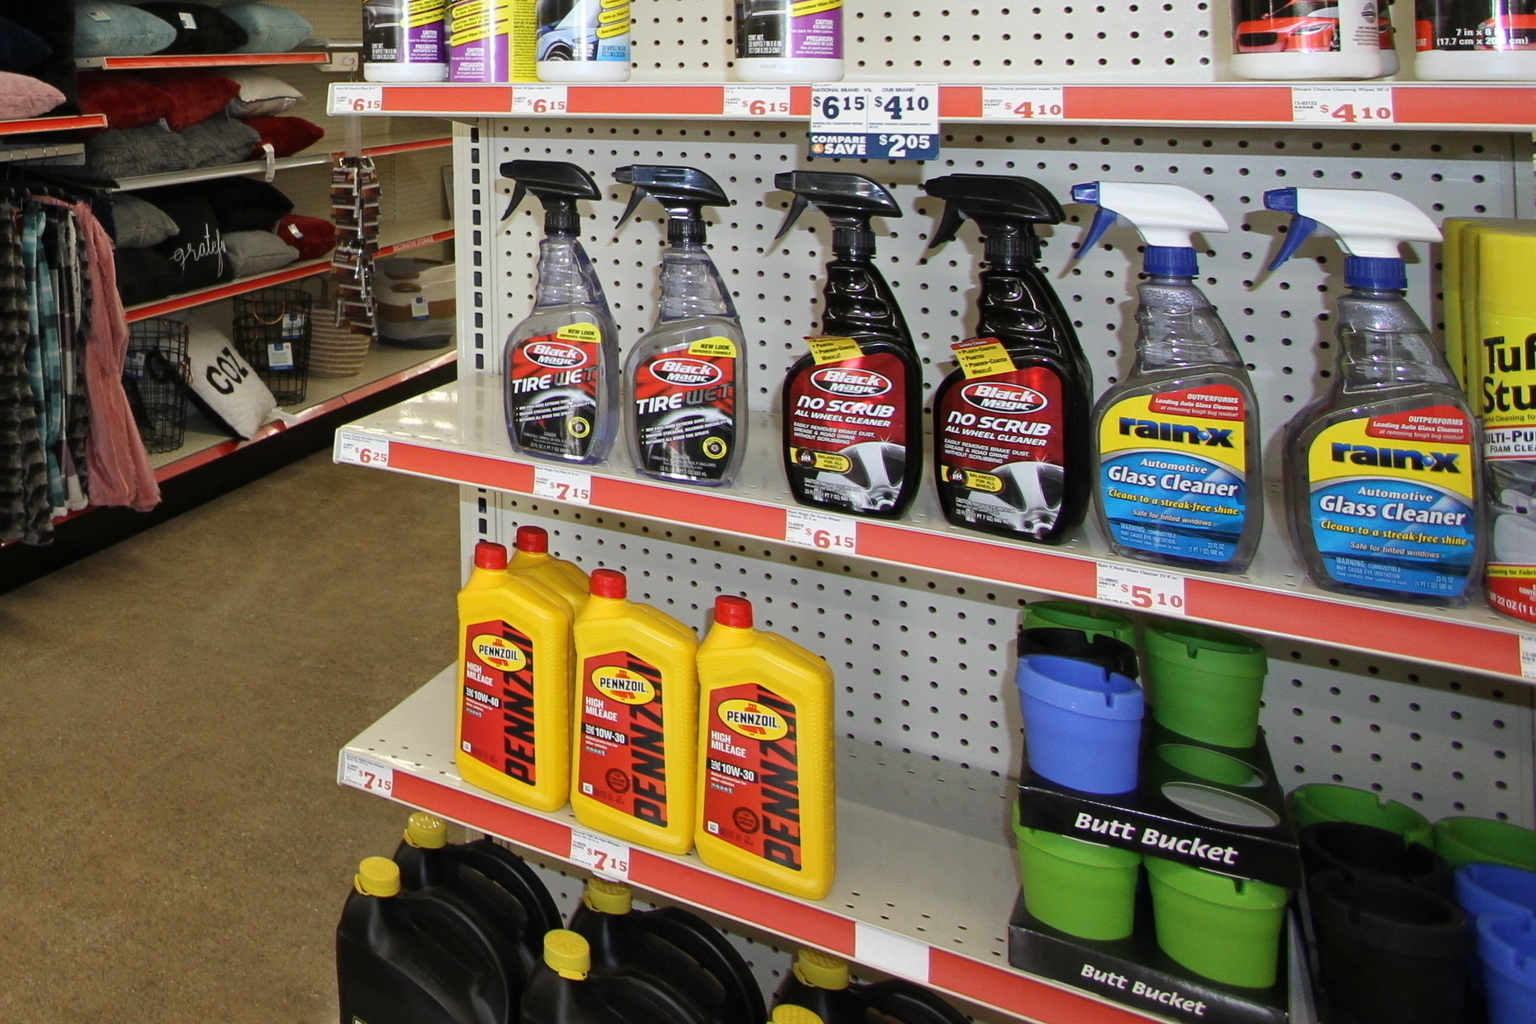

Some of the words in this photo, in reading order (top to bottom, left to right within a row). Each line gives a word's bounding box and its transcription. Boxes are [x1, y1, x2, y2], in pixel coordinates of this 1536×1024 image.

[811, 136, 866, 144] COMPARE
[170, 223, 226, 277] gratef
[533, 345, 578, 358] Black
[662, 361, 713, 375] Black
[512, 375, 551, 394] TIRE
[666, 372, 710, 383] Magic
[823, 370, 881, 387] Black
[830, 383, 878, 394] Magic
[974, 385, 1036, 403] Black
[636, 393, 683, 414] TIRE
[980, 399, 1032, 410] Magic
[1155, 398, 1178, 406] Leading
[1187, 393, 1238, 404] OUTPERFORMS
[826, 400, 895, 418] SCRUB
[977, 417, 1052, 436] SCRUB
[1409, 416, 1463, 426] OUTPERFORMS
[945, 426, 961, 435] ALL
[962, 429, 997, 440] WHEEL
[998, 434, 1047, 447] CLEANER
[1140, 458, 1208, 474] Automotive
[1108, 466, 1156, 487] Glass
[1161, 474, 1238, 497] Cleaner
[1109, 490, 1137, 502] Cleans
[1140, 495, 1150, 504] to
[1161, 499, 1211, 513] streak-free
[1214, 505, 1239, 515] shine
[1357, 486, 1433, 503] Automotive
[1319, 495, 1376, 517] Glass
[1382, 503, 1466, 526] Cleaner
[479, 644, 519, 661] PENNZOIL
[467, 661, 482, 675] HIGH
[467, 670, 494, 688] MILEAGE
[600, 677, 646, 693] PENNZOIL
[474, 691, 499, 708] 10W-40
[586, 696, 604, 709] HIGH
[586, 705, 618, 722] MILEAGE
[727, 711, 777, 728] PENNZOIL
[595, 727, 625, 744] 10W-30
[711, 731, 731, 744] HIGH
[711, 740, 746, 758] MILEAGE
[722, 762, 755, 782] 10W-30
[1074, 810, 1137, 842] Butt
[1141, 827, 1239, 867] Bucket
[1080, 962, 1130, 993] Butt
[1132, 979, 1207, 1018] Bucket
